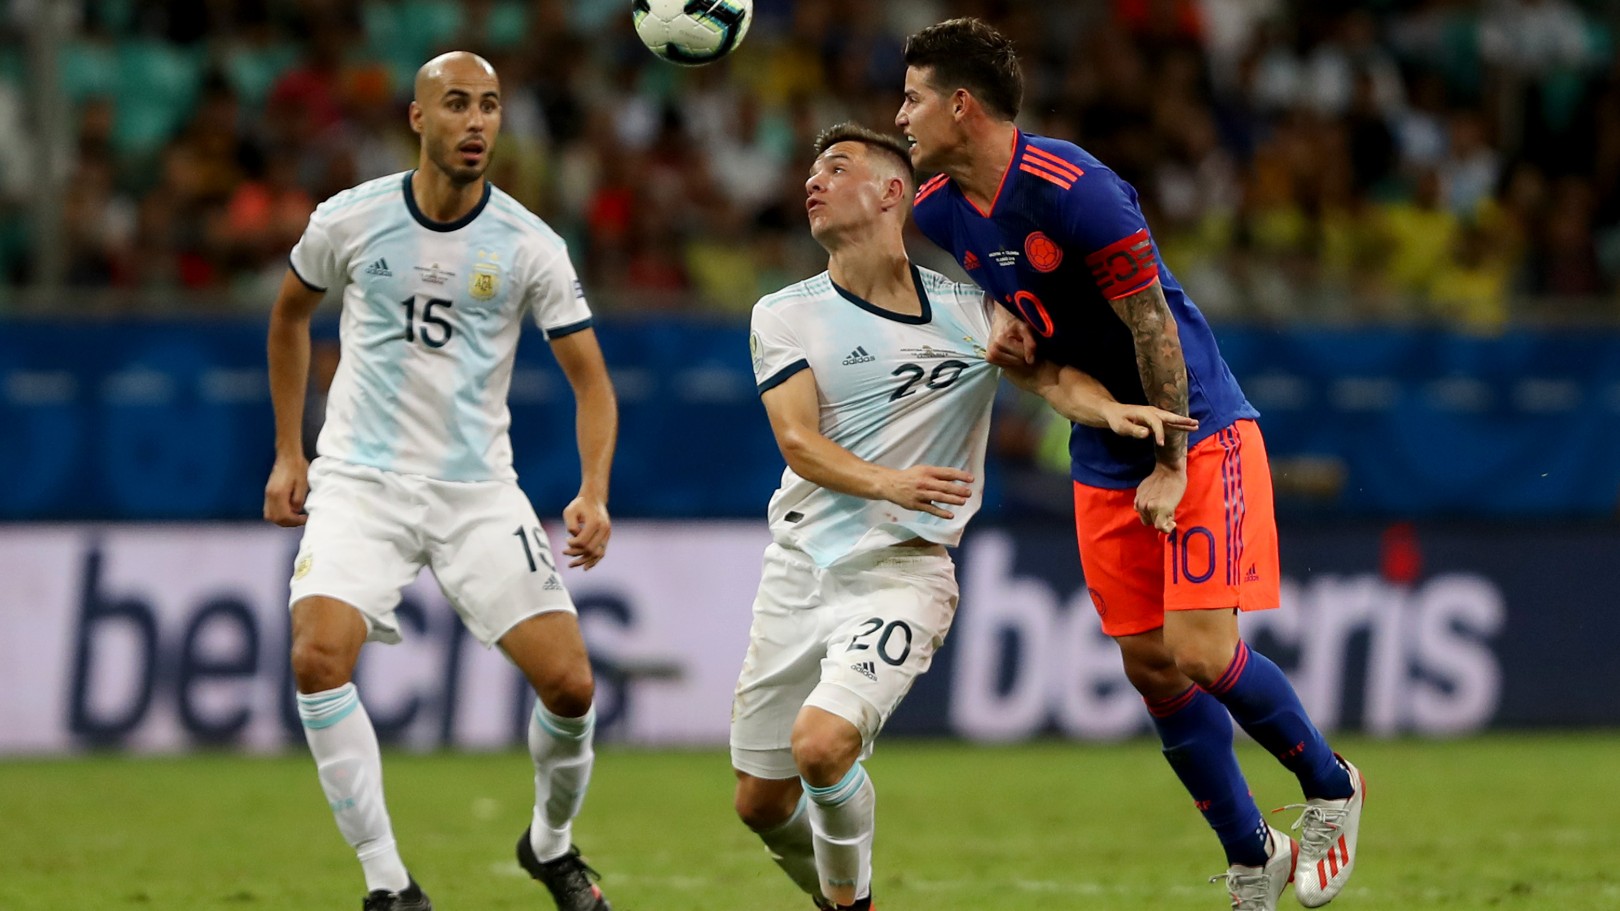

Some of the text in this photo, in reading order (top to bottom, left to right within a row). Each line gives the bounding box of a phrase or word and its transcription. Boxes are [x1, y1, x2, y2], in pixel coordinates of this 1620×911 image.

[401, 295, 453, 348] 15
[842, 355, 876, 366] adidas
[889, 360, 969, 402] 20
[1168, 526, 1216, 584] 10
[846, 617, 912, 666] 20
[851, 664, 878, 682] adidas
